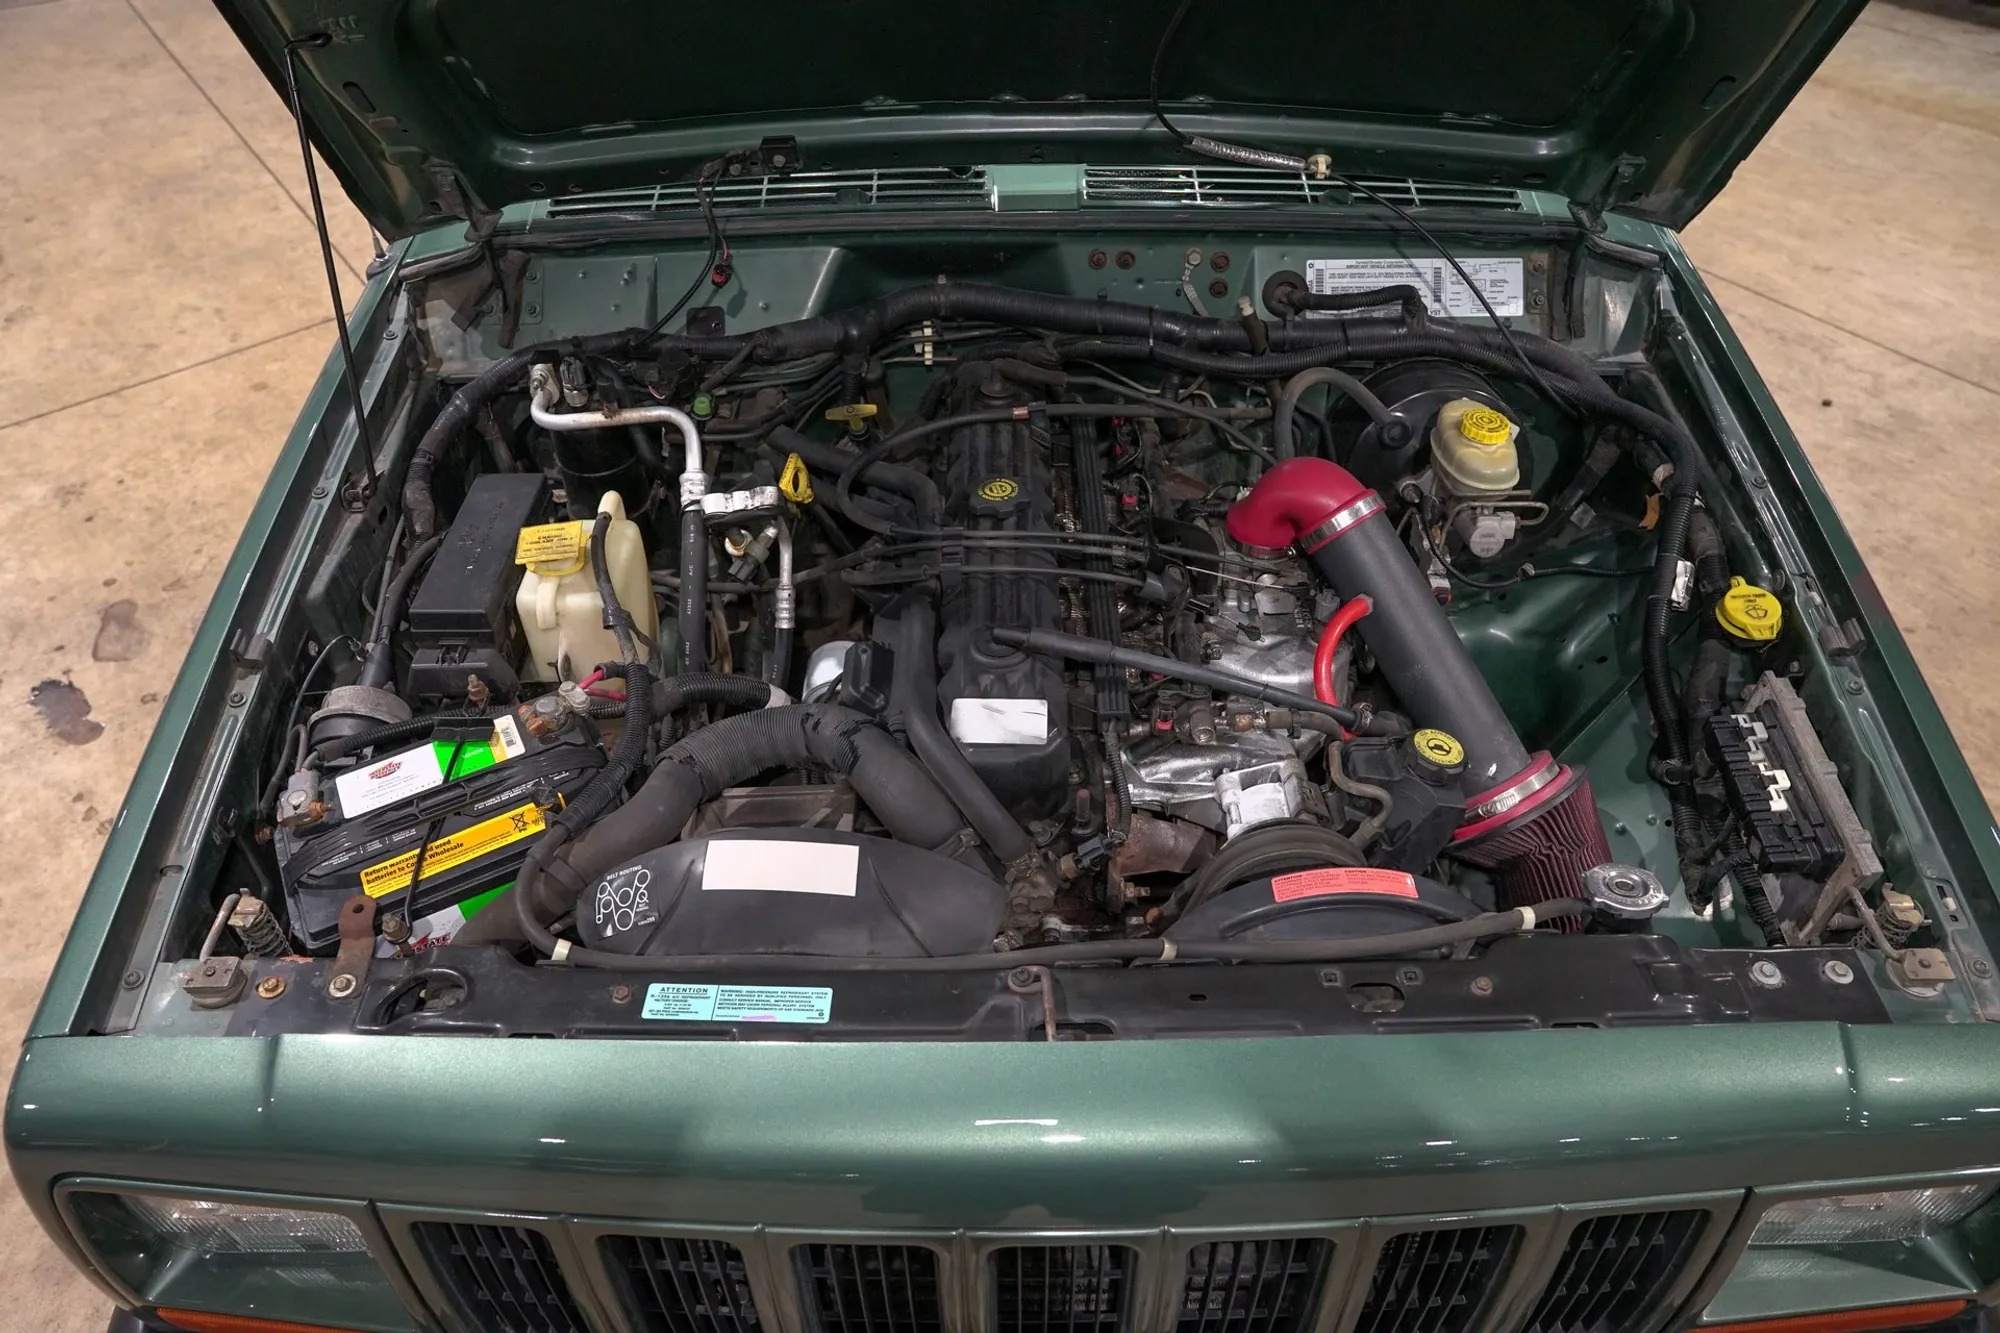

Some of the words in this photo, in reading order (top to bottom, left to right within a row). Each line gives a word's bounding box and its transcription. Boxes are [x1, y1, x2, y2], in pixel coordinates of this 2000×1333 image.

[434, 839, 451, 849] used
[366, 870, 396, 884] batteries
[428, 842, 464, 860] Wholesale
[364, 865, 388, 878] Return
